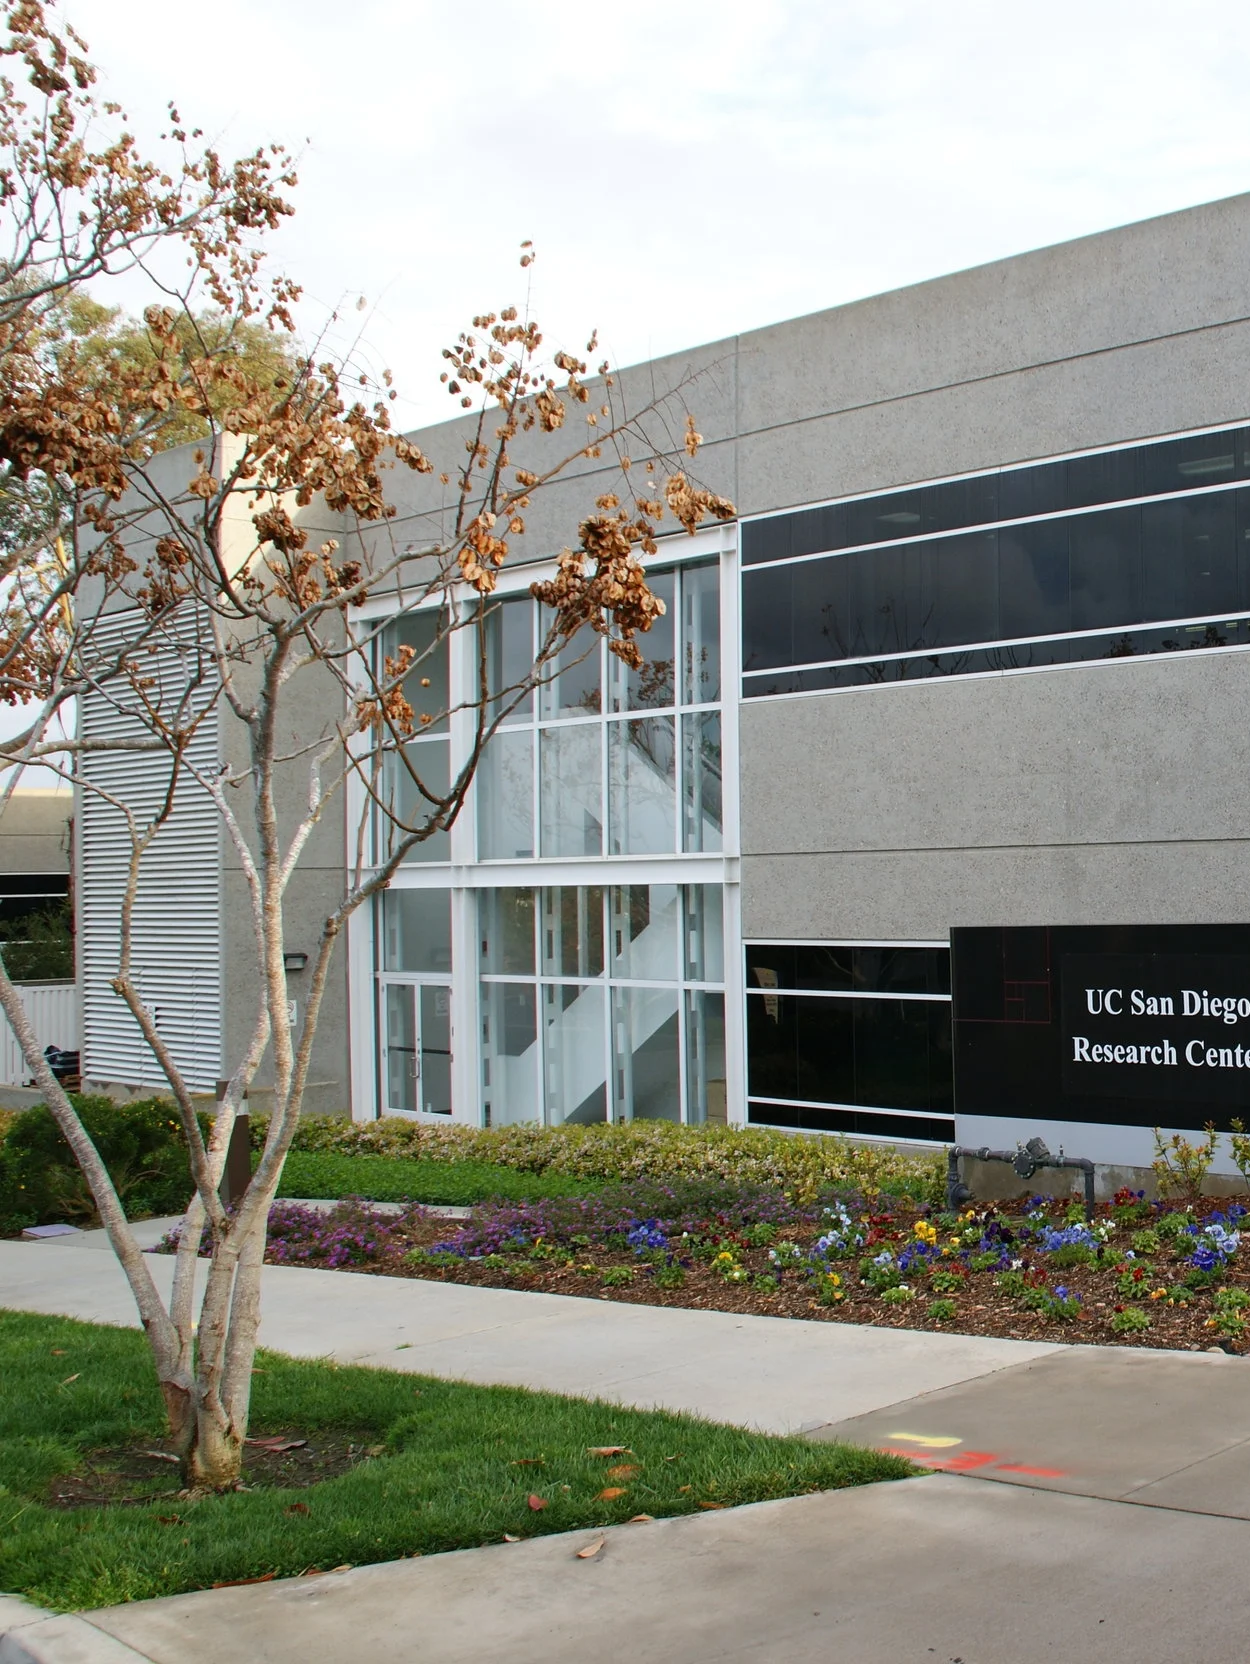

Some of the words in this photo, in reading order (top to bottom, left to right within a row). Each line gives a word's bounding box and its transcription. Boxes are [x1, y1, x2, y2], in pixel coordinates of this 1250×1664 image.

[1085, 988, 1123, 1015] UC
[1131, 989, 1174, 1016] San
[1072, 1037, 1178, 1065] Research
